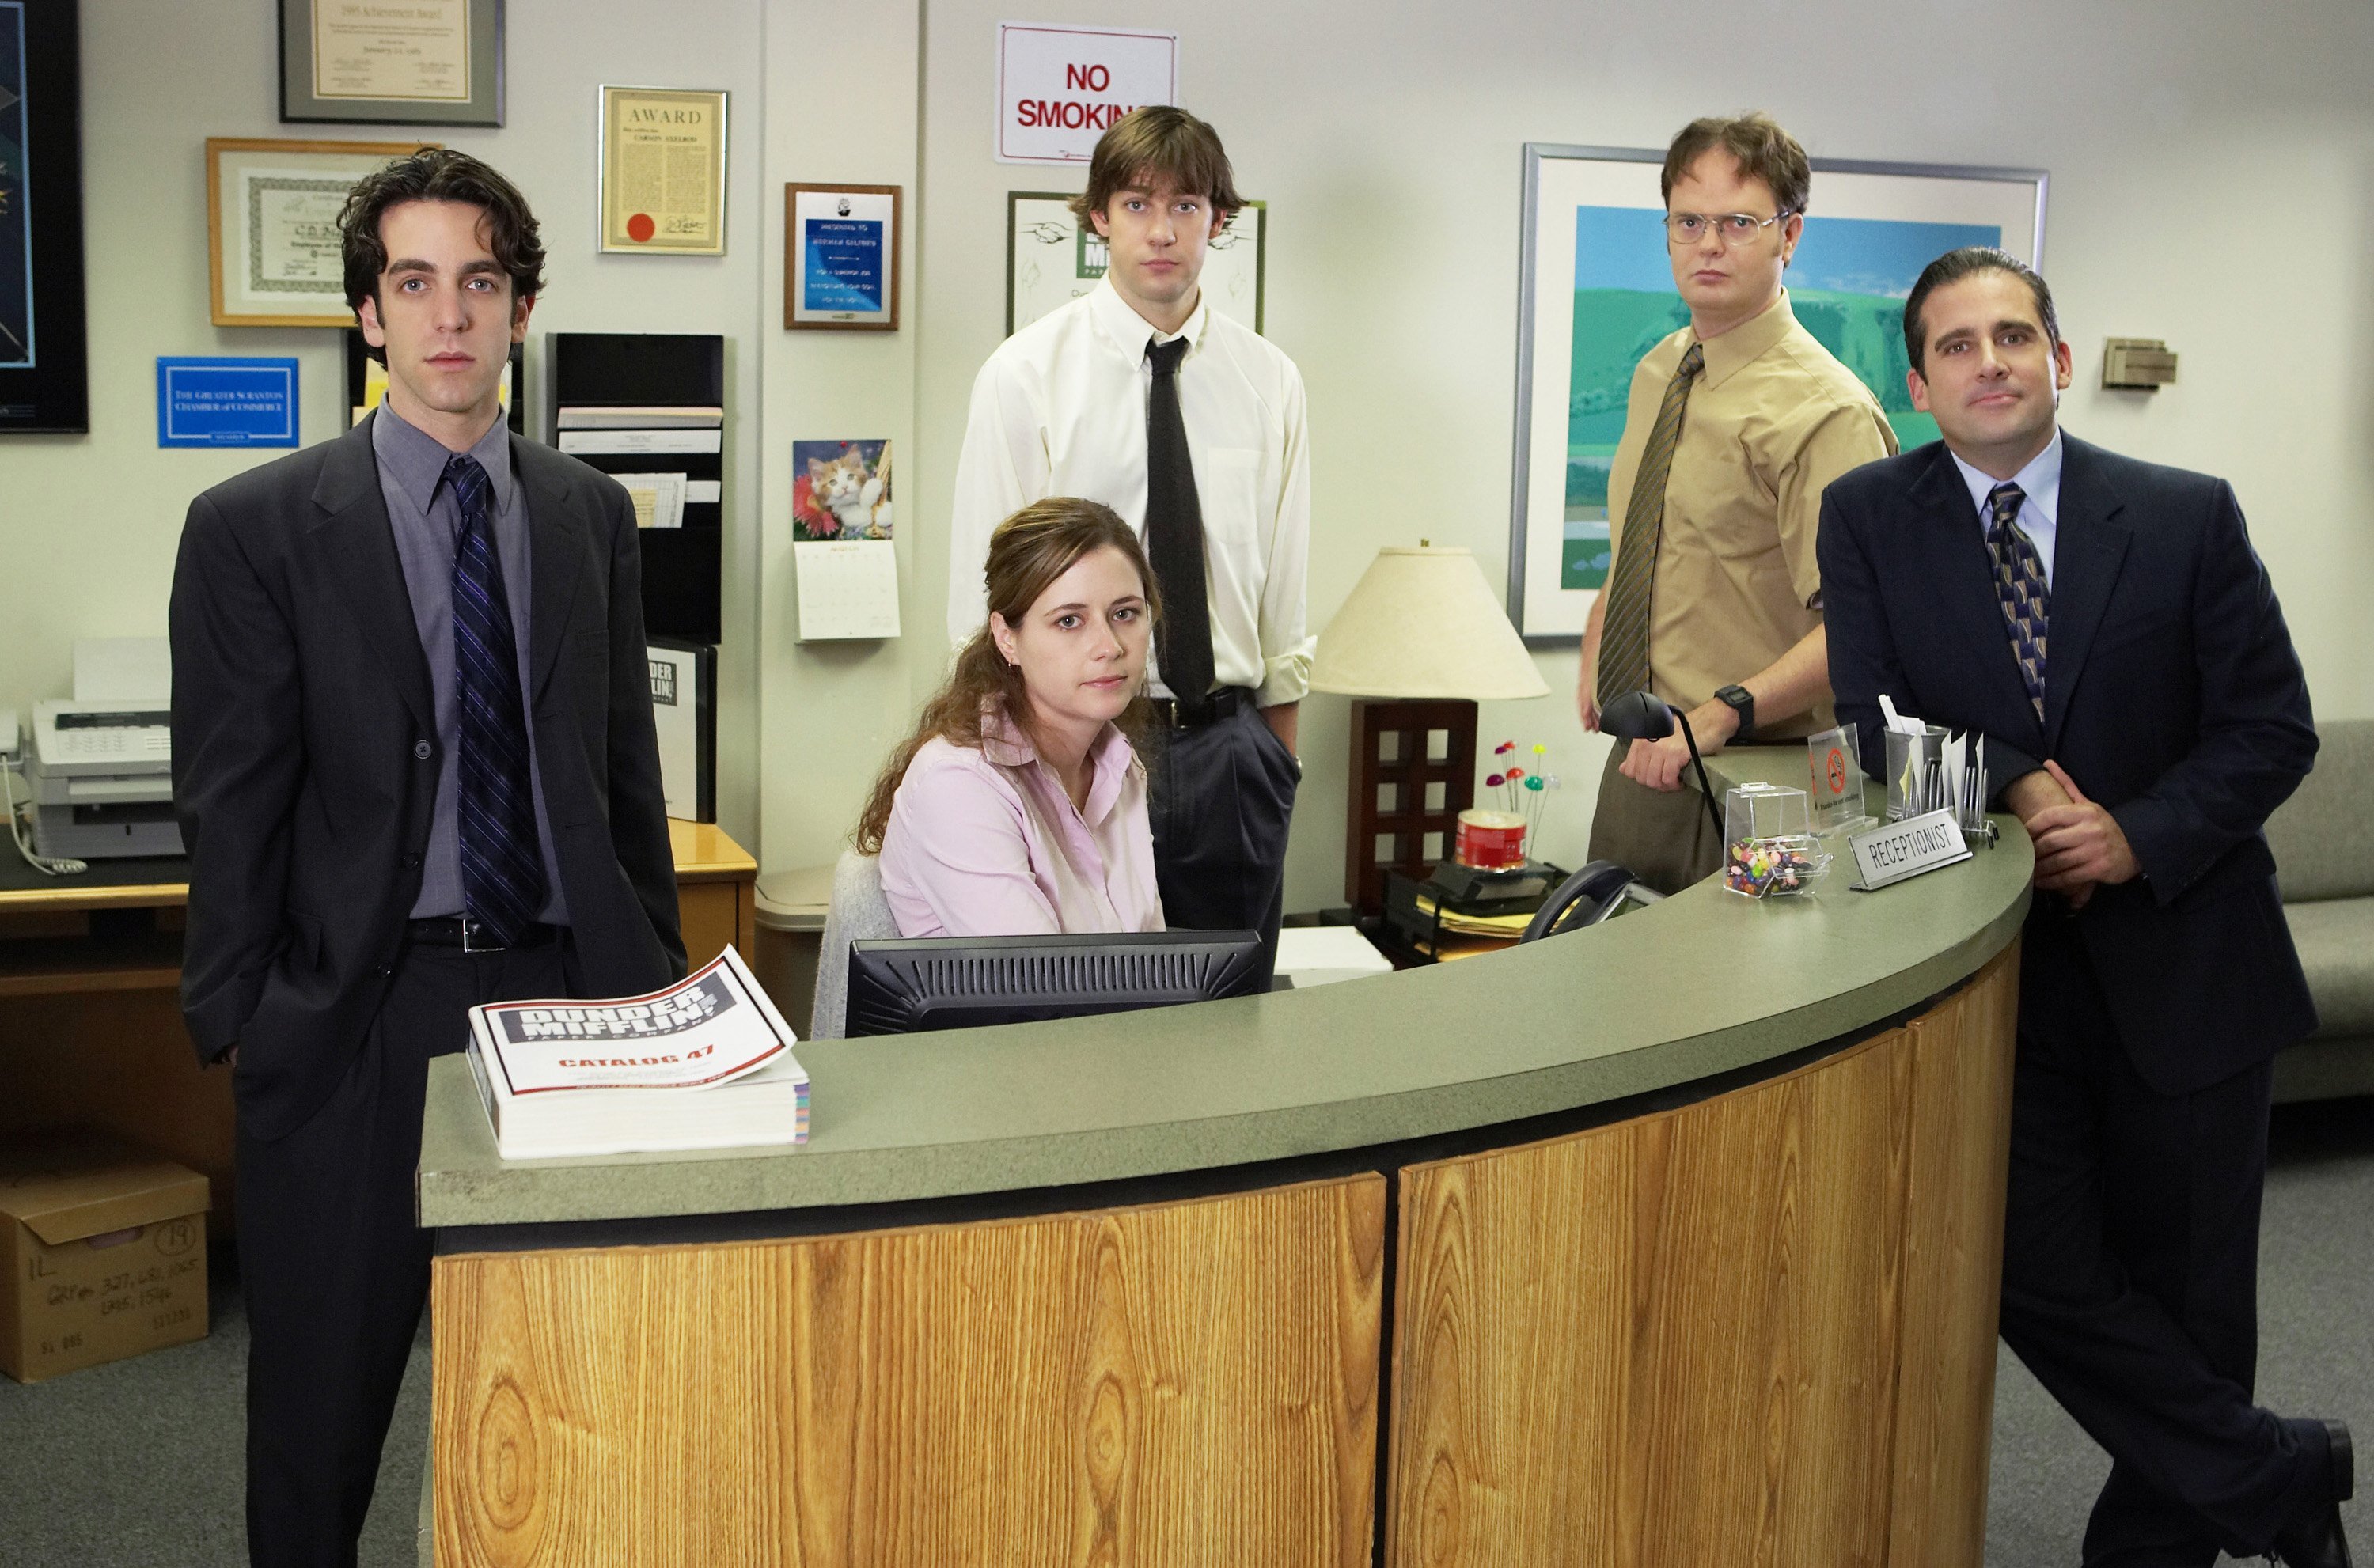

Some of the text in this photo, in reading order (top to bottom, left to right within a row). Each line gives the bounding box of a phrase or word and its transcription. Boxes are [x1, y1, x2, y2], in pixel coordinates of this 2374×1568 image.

[1066, 62, 1110, 92] NO
[629, 108, 701, 124] AWARD
[175, 403, 220, 411] CHAMBER
[230, 403, 282, 411] COMMERCE
[195, 391, 235, 400] GREATER
[236, 391, 283, 400] SCRANTON
[1868, 824, 1951, 869] RECEPTIONIST
[519, 986, 705, 1024] DUNDER
[612, 1017, 702, 1039] COMPANY
[559, 1044, 714, 1068] CATALOG 47
